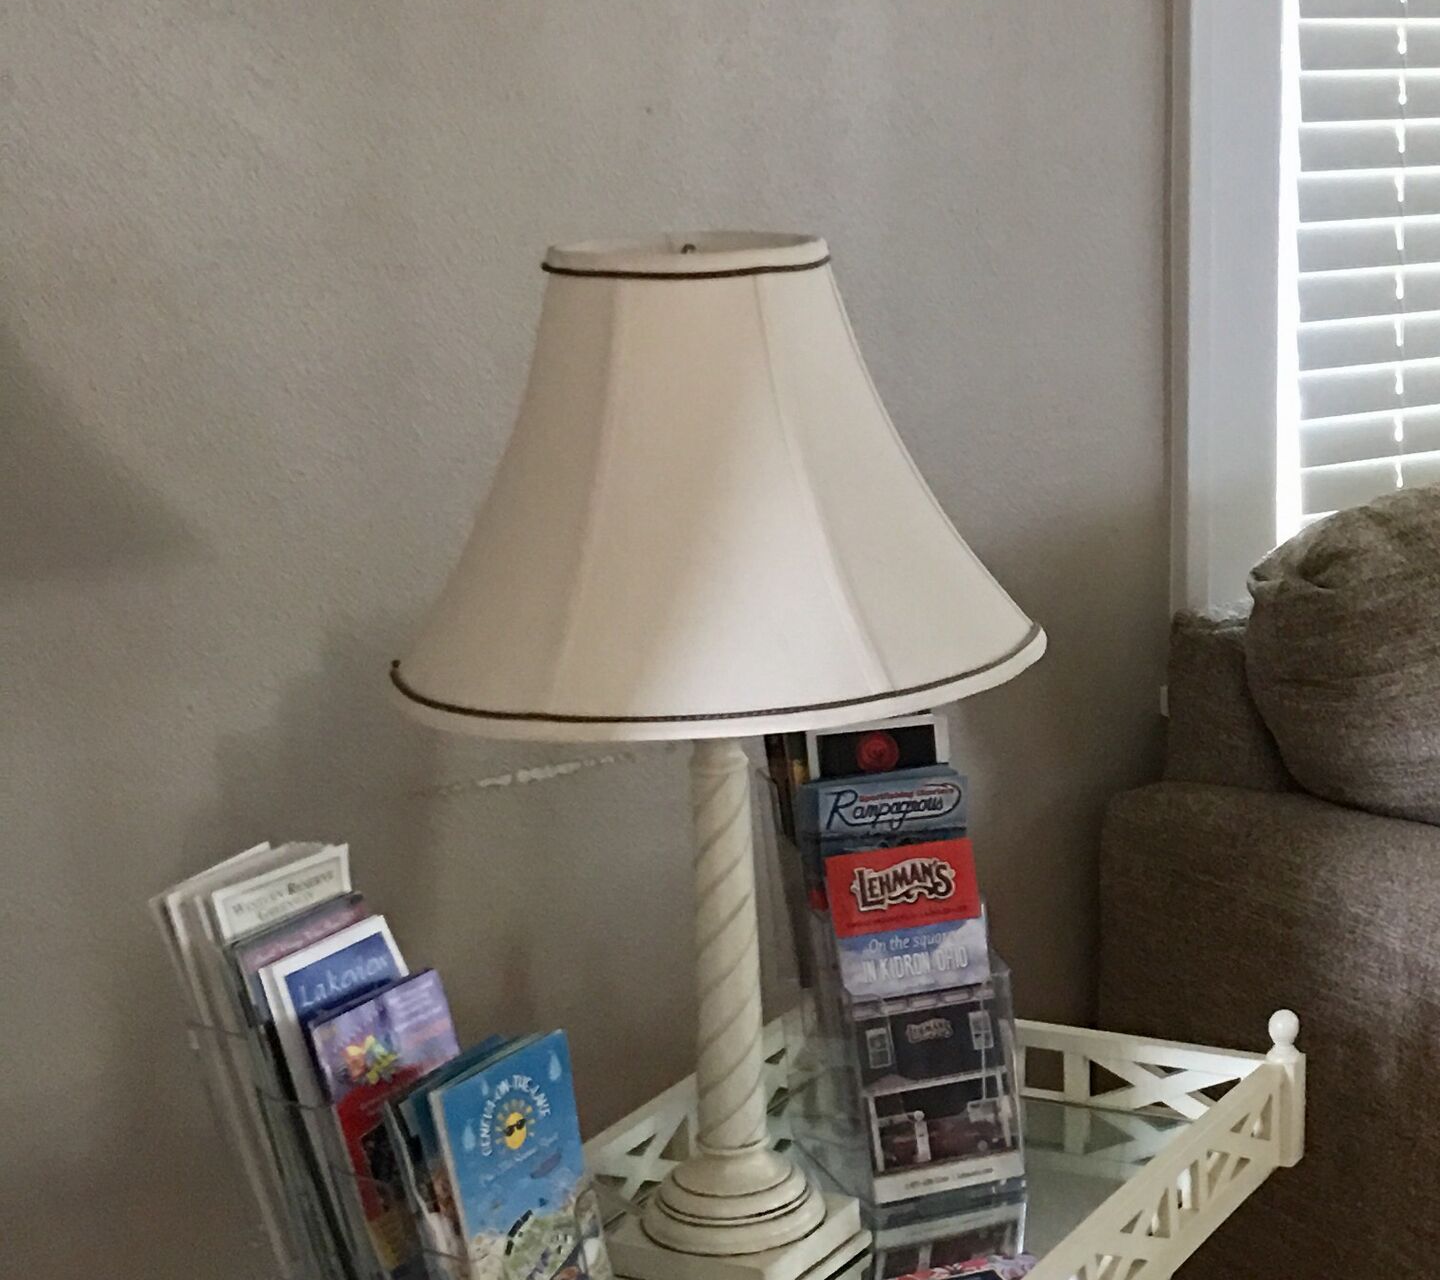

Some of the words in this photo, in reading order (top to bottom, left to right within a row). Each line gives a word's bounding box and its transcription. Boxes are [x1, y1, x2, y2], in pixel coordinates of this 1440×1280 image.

[853, 860, 955, 910] LEHMAN'S
[868, 938, 886, 953] On
[890, 936, 910, 949] the
